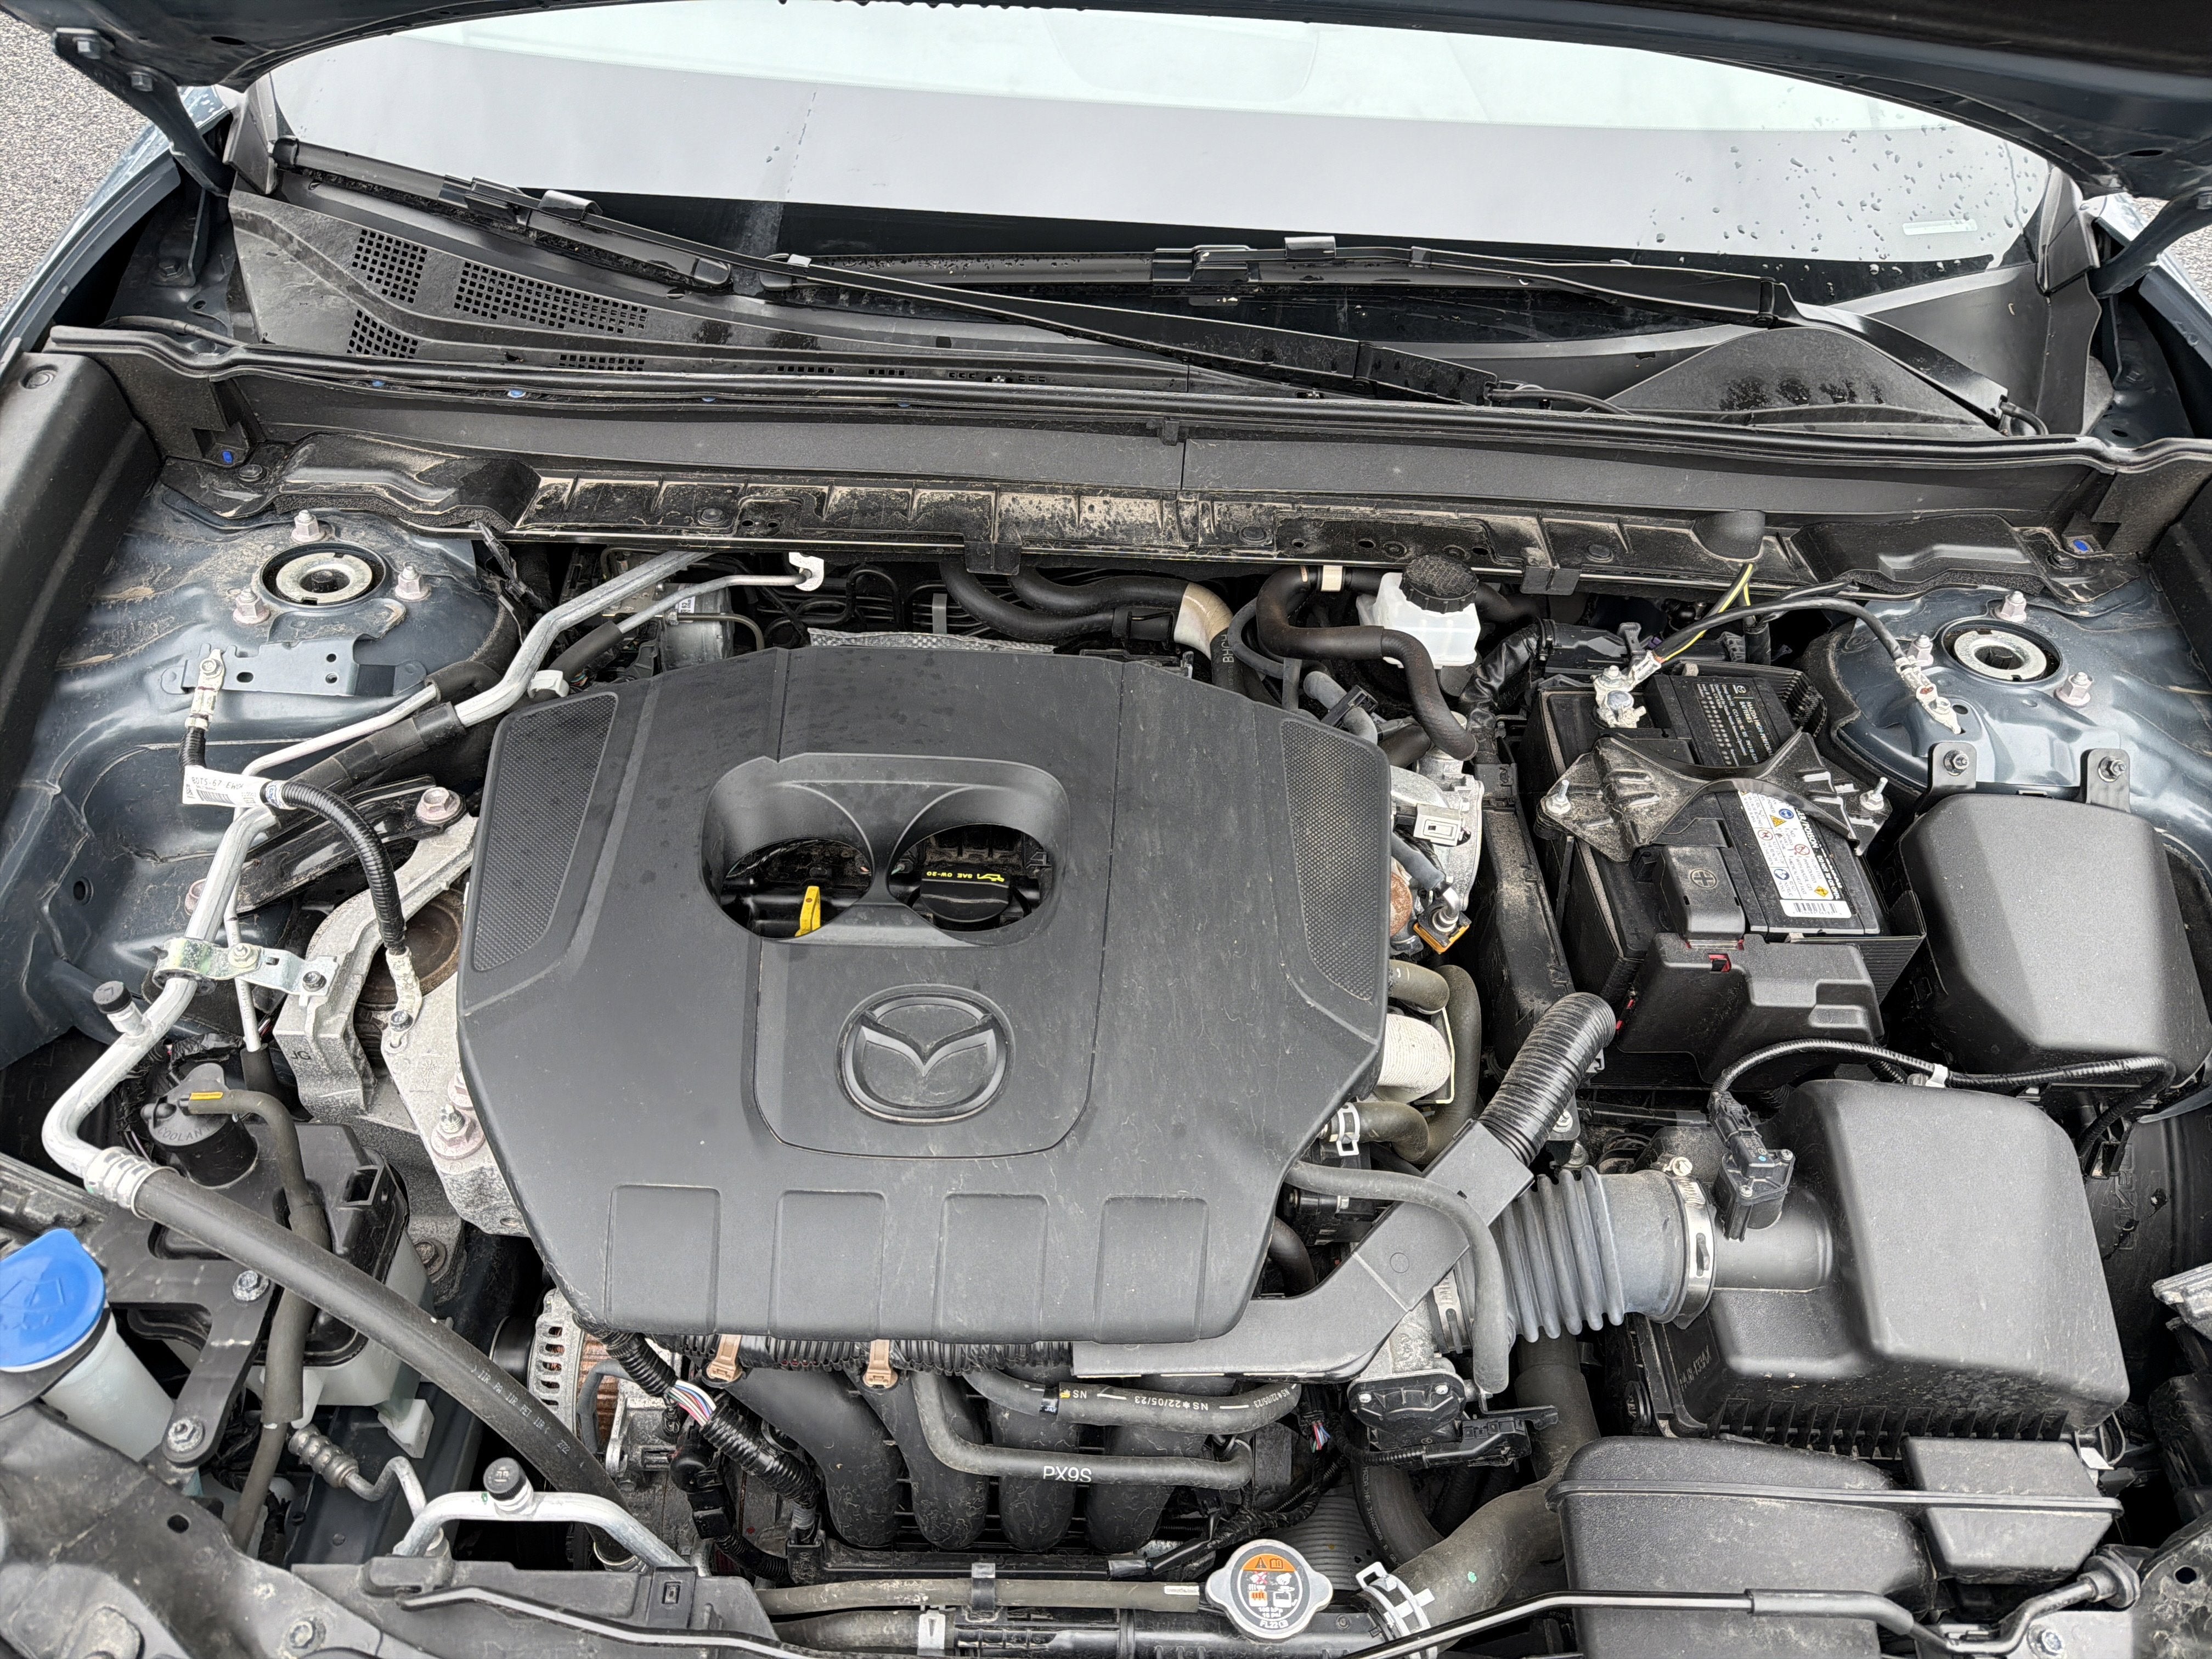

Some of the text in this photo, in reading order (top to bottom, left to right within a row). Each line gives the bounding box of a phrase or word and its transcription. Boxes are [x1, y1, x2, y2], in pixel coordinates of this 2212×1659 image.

[1739, 701, 1753, 723] BATTERIES
[1745, 702, 1758, 719] MAZDA
[291, 1049, 312, 1060] JG
[157, 1126, 212, 1142] COOLANT
[1042, 1464, 1092, 1483] PX9S
[1259, 1620, 1278, 1628] FL22
